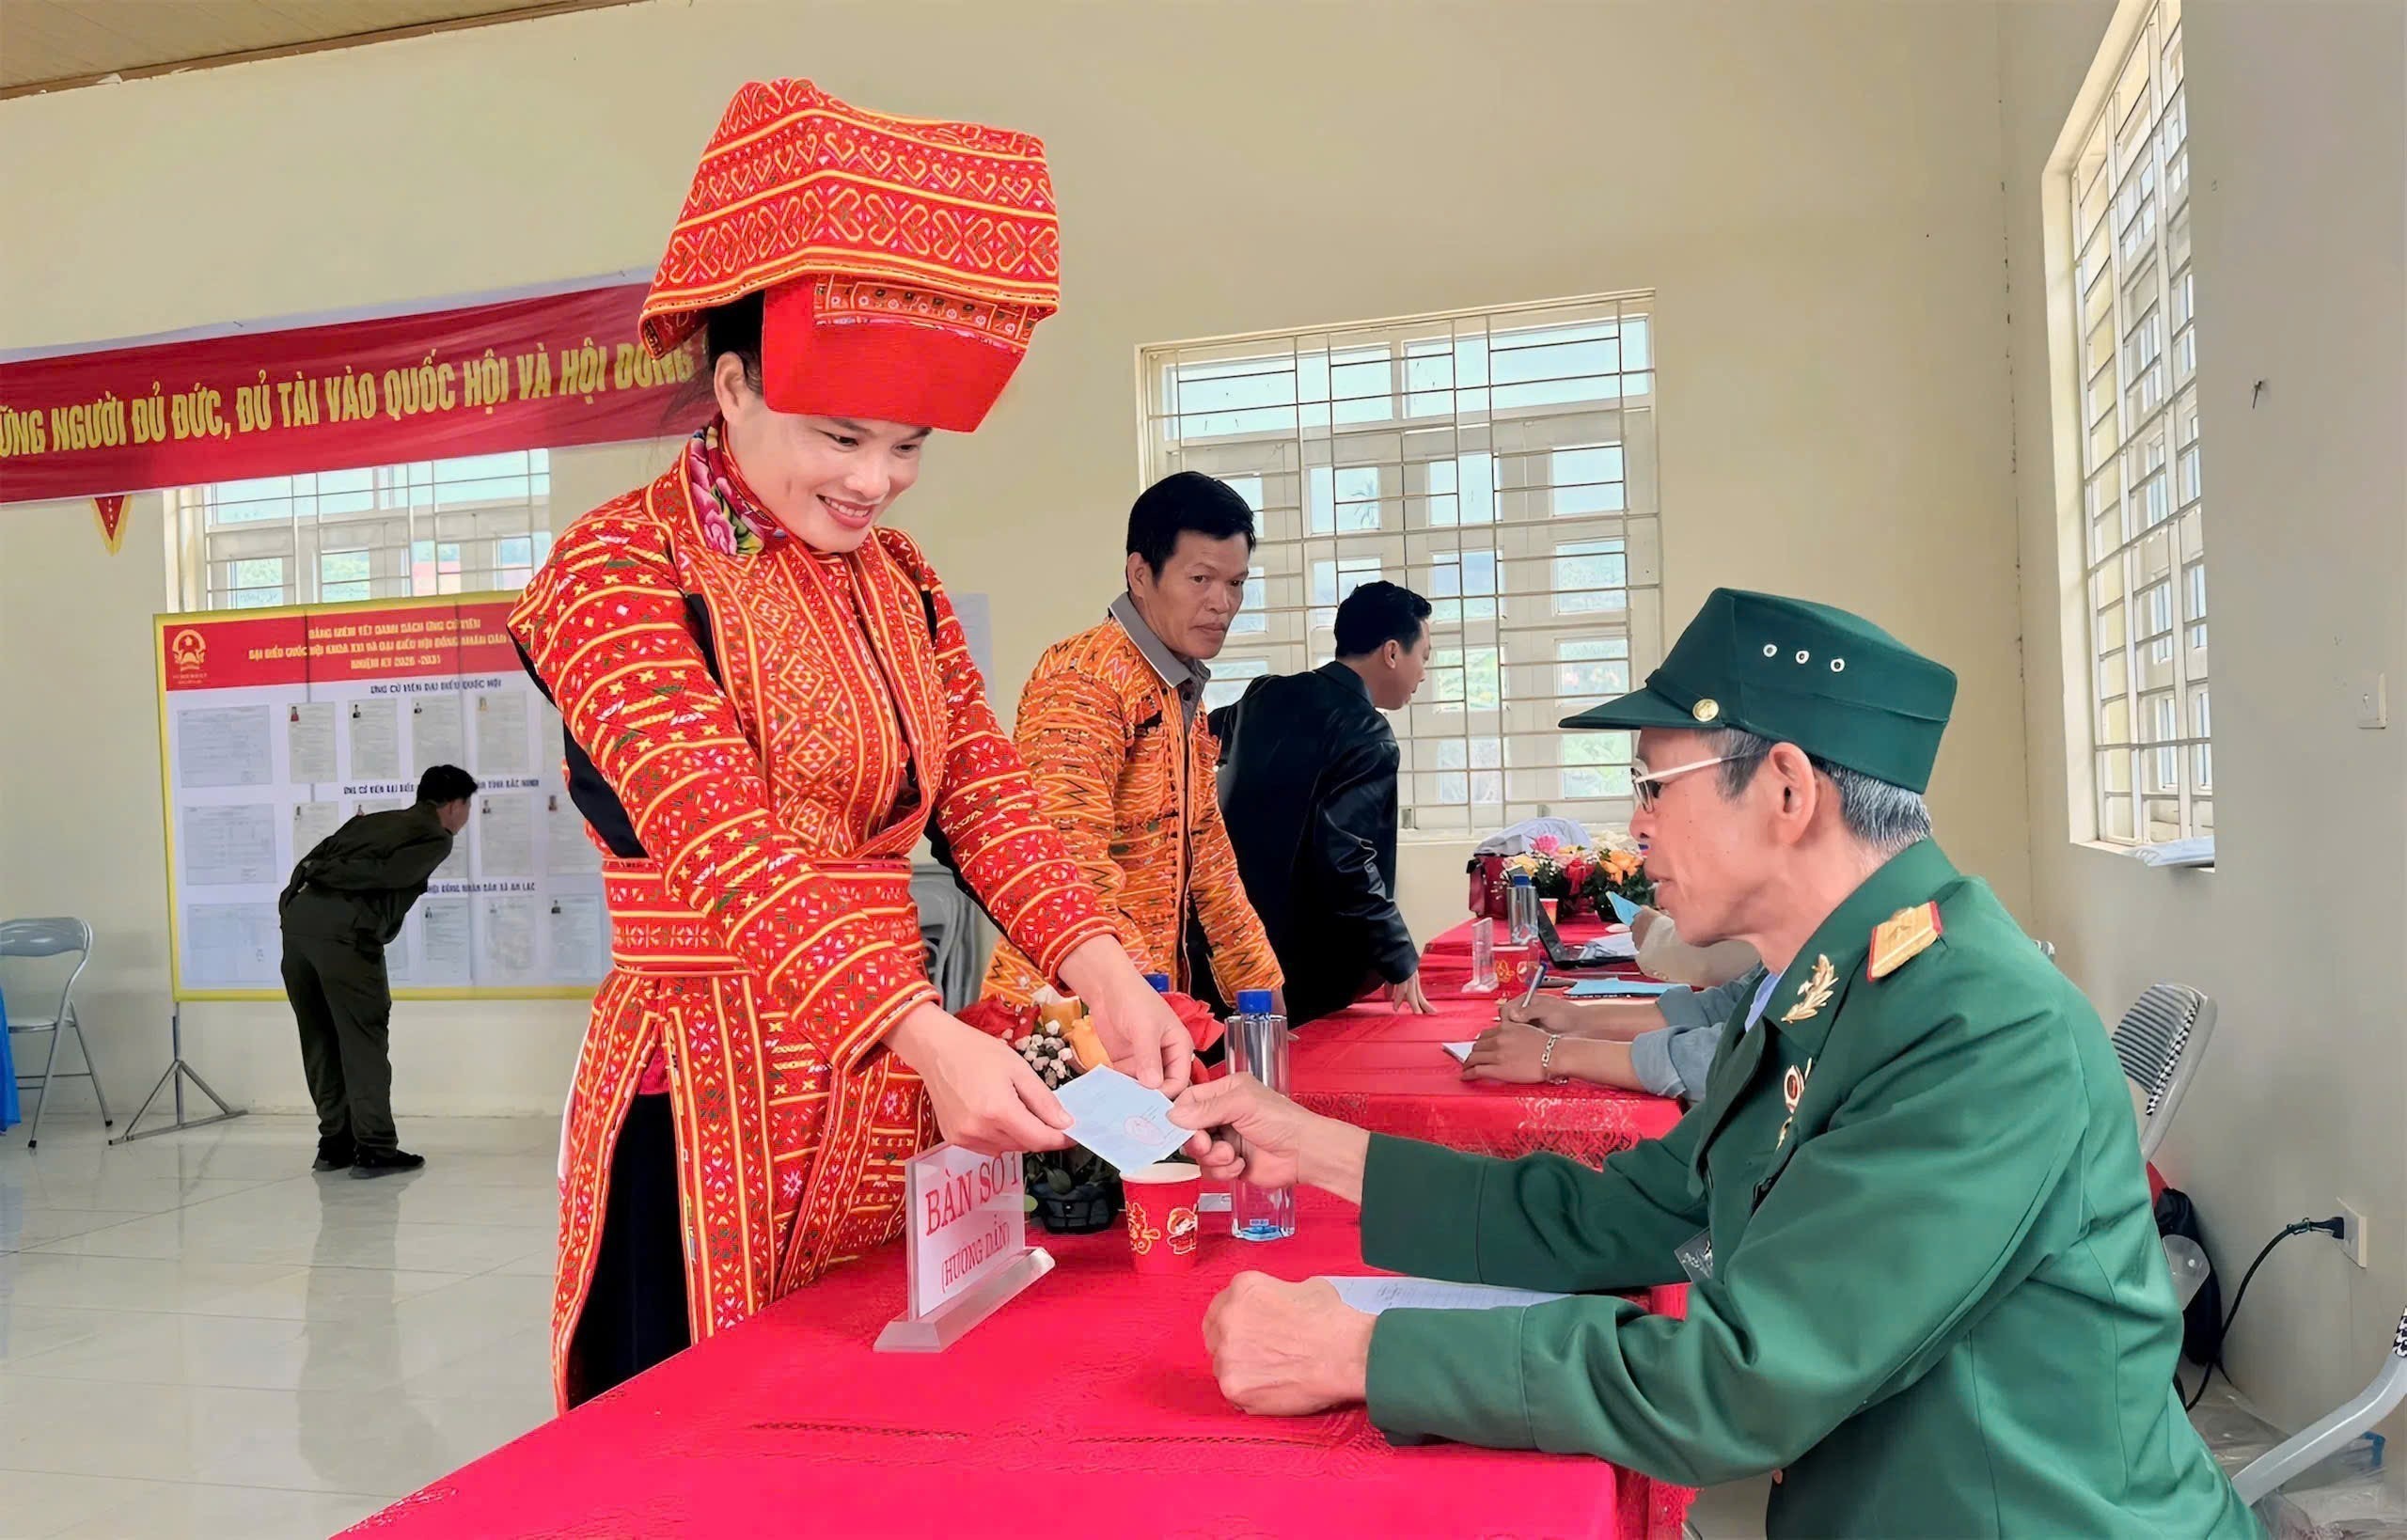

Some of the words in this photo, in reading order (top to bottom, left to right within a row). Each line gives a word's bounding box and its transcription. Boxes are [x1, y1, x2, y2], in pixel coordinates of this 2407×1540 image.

[51, 390, 128, 451] NGƯỜI
[132, 381, 166, 444] ĐỦ
[171, 382, 231, 440] ĐỨC,
[236, 369, 273, 432] ĐỦ
[277, 371, 320, 428] TÀI
[324, 365, 377, 422] VÀO
[384, 349, 455, 421] QUỐC
[463, 348, 509, 415] HỘI
[517, 342, 552, 400] VÀ
[559, 337, 606, 404] HỘI
[925, 1168, 972, 1237] BÀN
